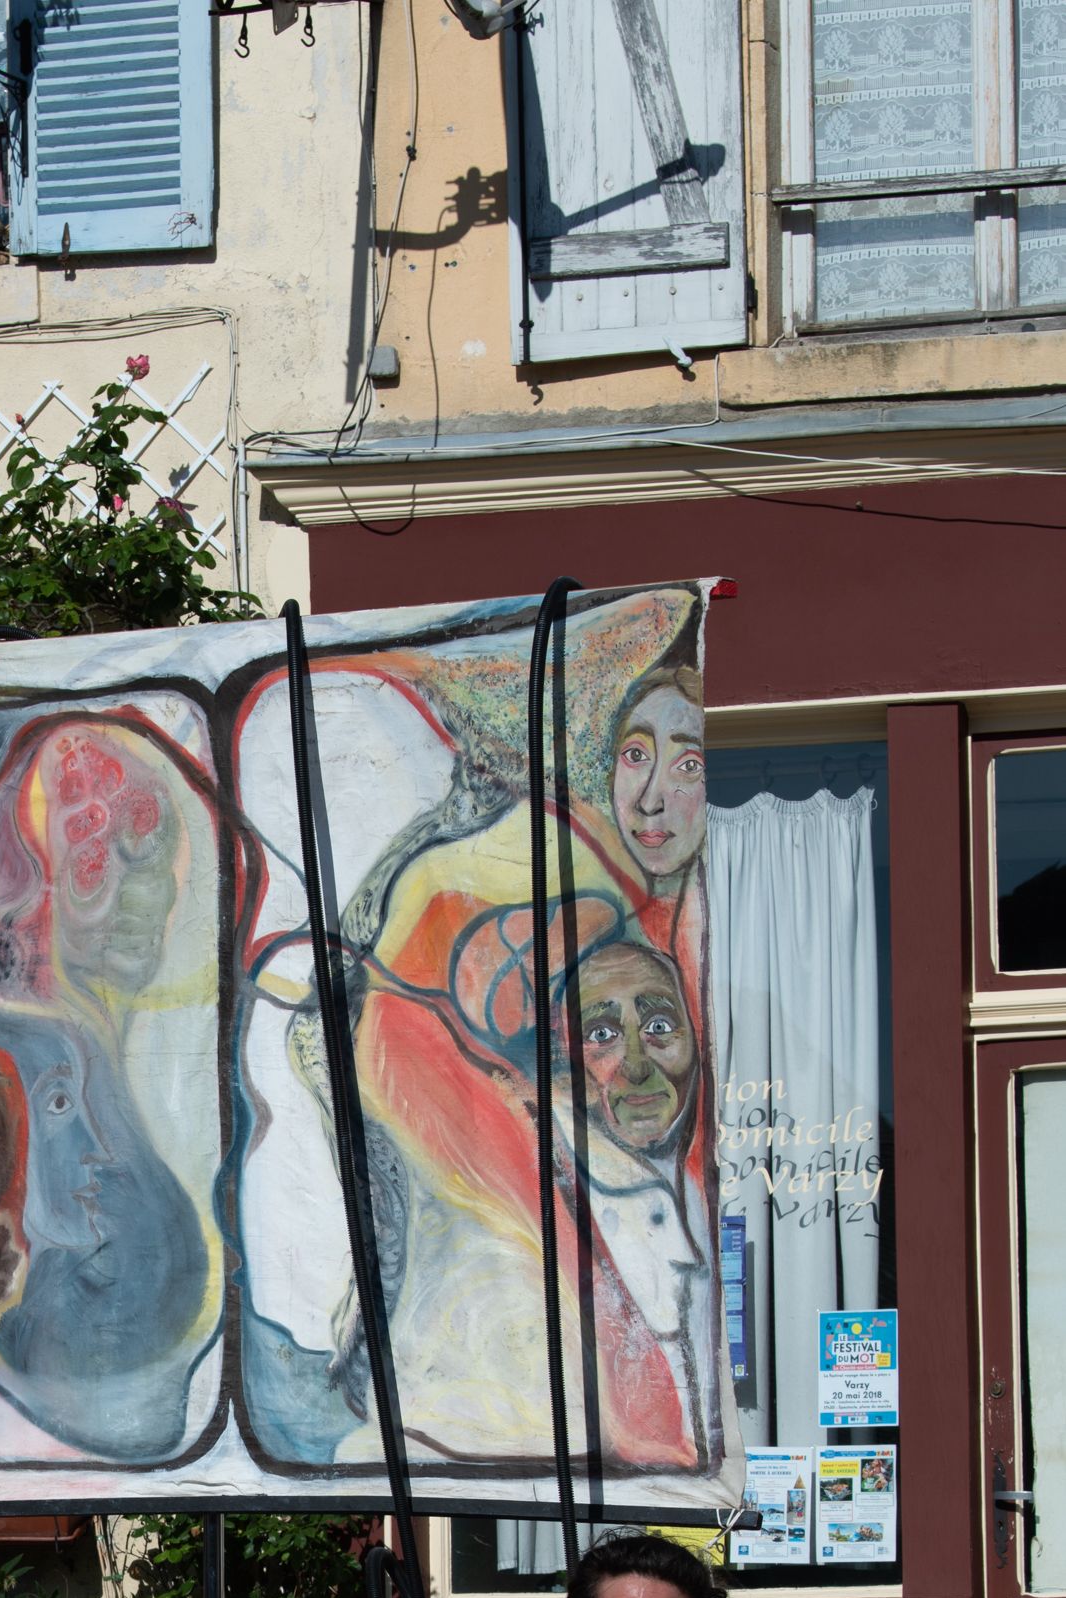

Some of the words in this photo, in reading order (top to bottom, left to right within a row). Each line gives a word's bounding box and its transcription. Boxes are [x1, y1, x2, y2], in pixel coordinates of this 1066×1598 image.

[719, 1073, 787, 1102] ion
[754, 1167, 884, 1206] Varzy
[850, 1353, 875, 1363] MOT
[845, 1380, 870, 1390] Varzy
[832, 1392, 843, 1400] 20
[845, 1391, 861, 1399] mai
[863, 1391, 882, 1399] 2018
